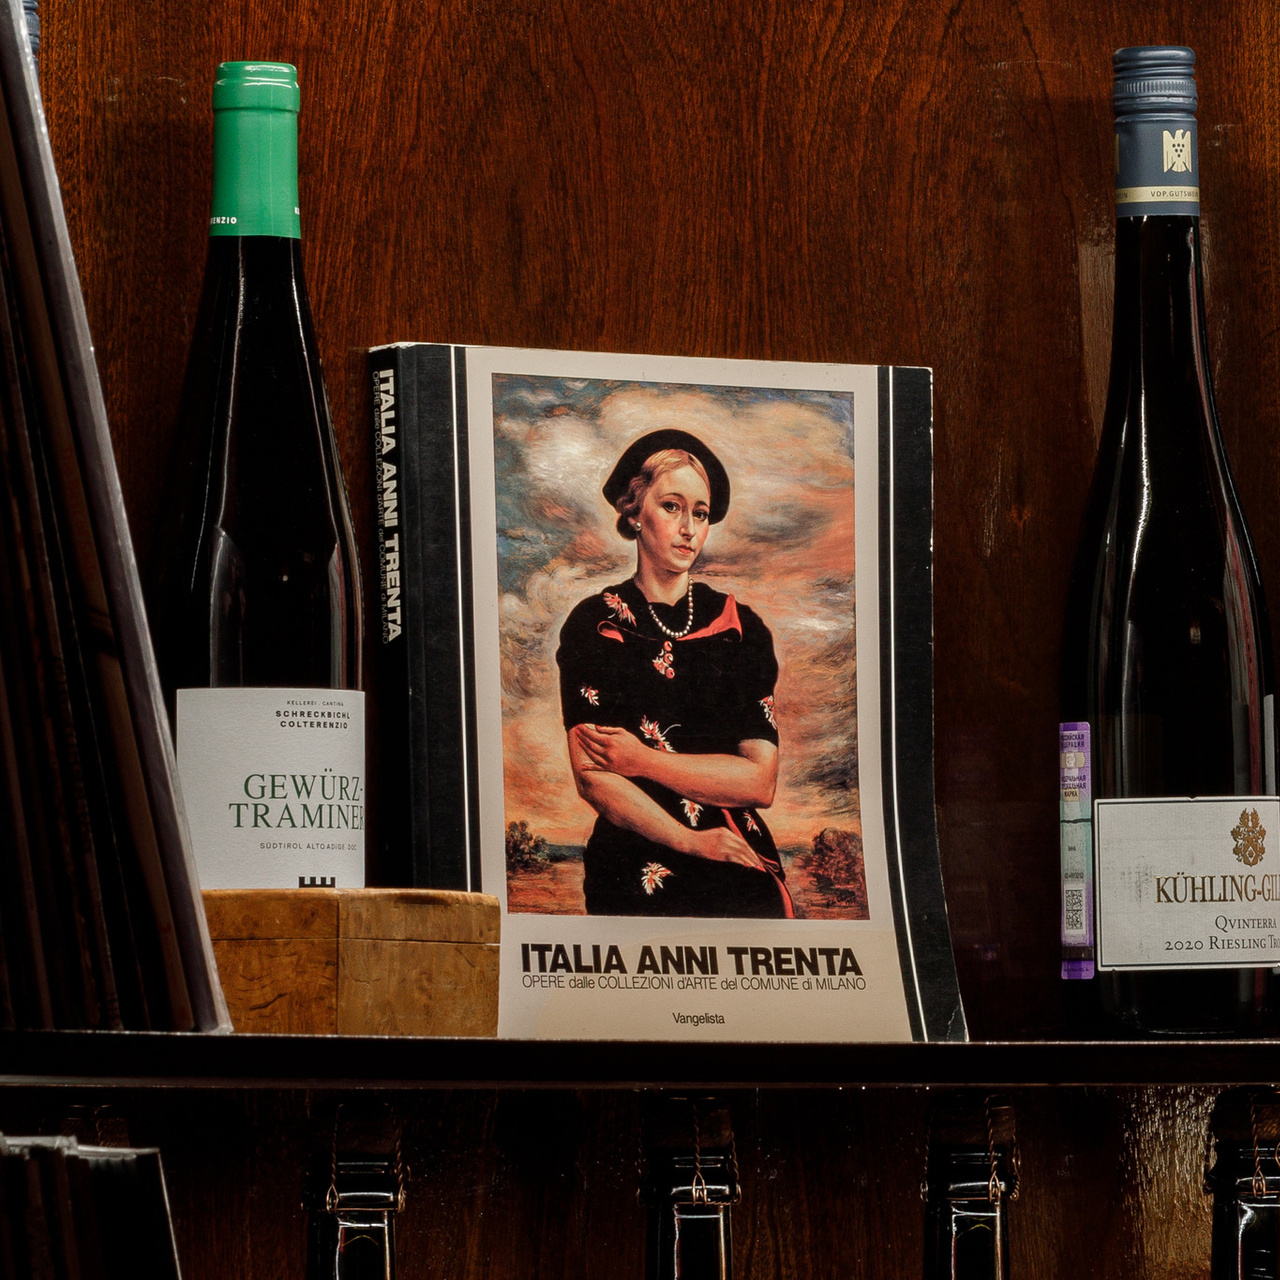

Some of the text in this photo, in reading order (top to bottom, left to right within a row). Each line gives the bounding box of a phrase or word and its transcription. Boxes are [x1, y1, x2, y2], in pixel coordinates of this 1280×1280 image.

[379, 369, 402, 643] ITALIA ANNI TRENTA
[275, 710, 351, 719] SCHRECKBICHL
[280, 720, 348, 729] COLTERENZIO
[260, 841, 303, 850] SÜDTIROL
[306, 842, 325, 850] ALTO
[326, 842, 346, 851] ADIGE
[1165, 935, 1267, 951] 2020 RIESLING
[521, 943, 863, 976] ITALIA ANNI TRENTA
[522, 975, 866, 992] OPERE dalle COLLEZIONI d'ARTE del COMUNE di MILANO
[672, 1012, 725, 1027] Vangelista
